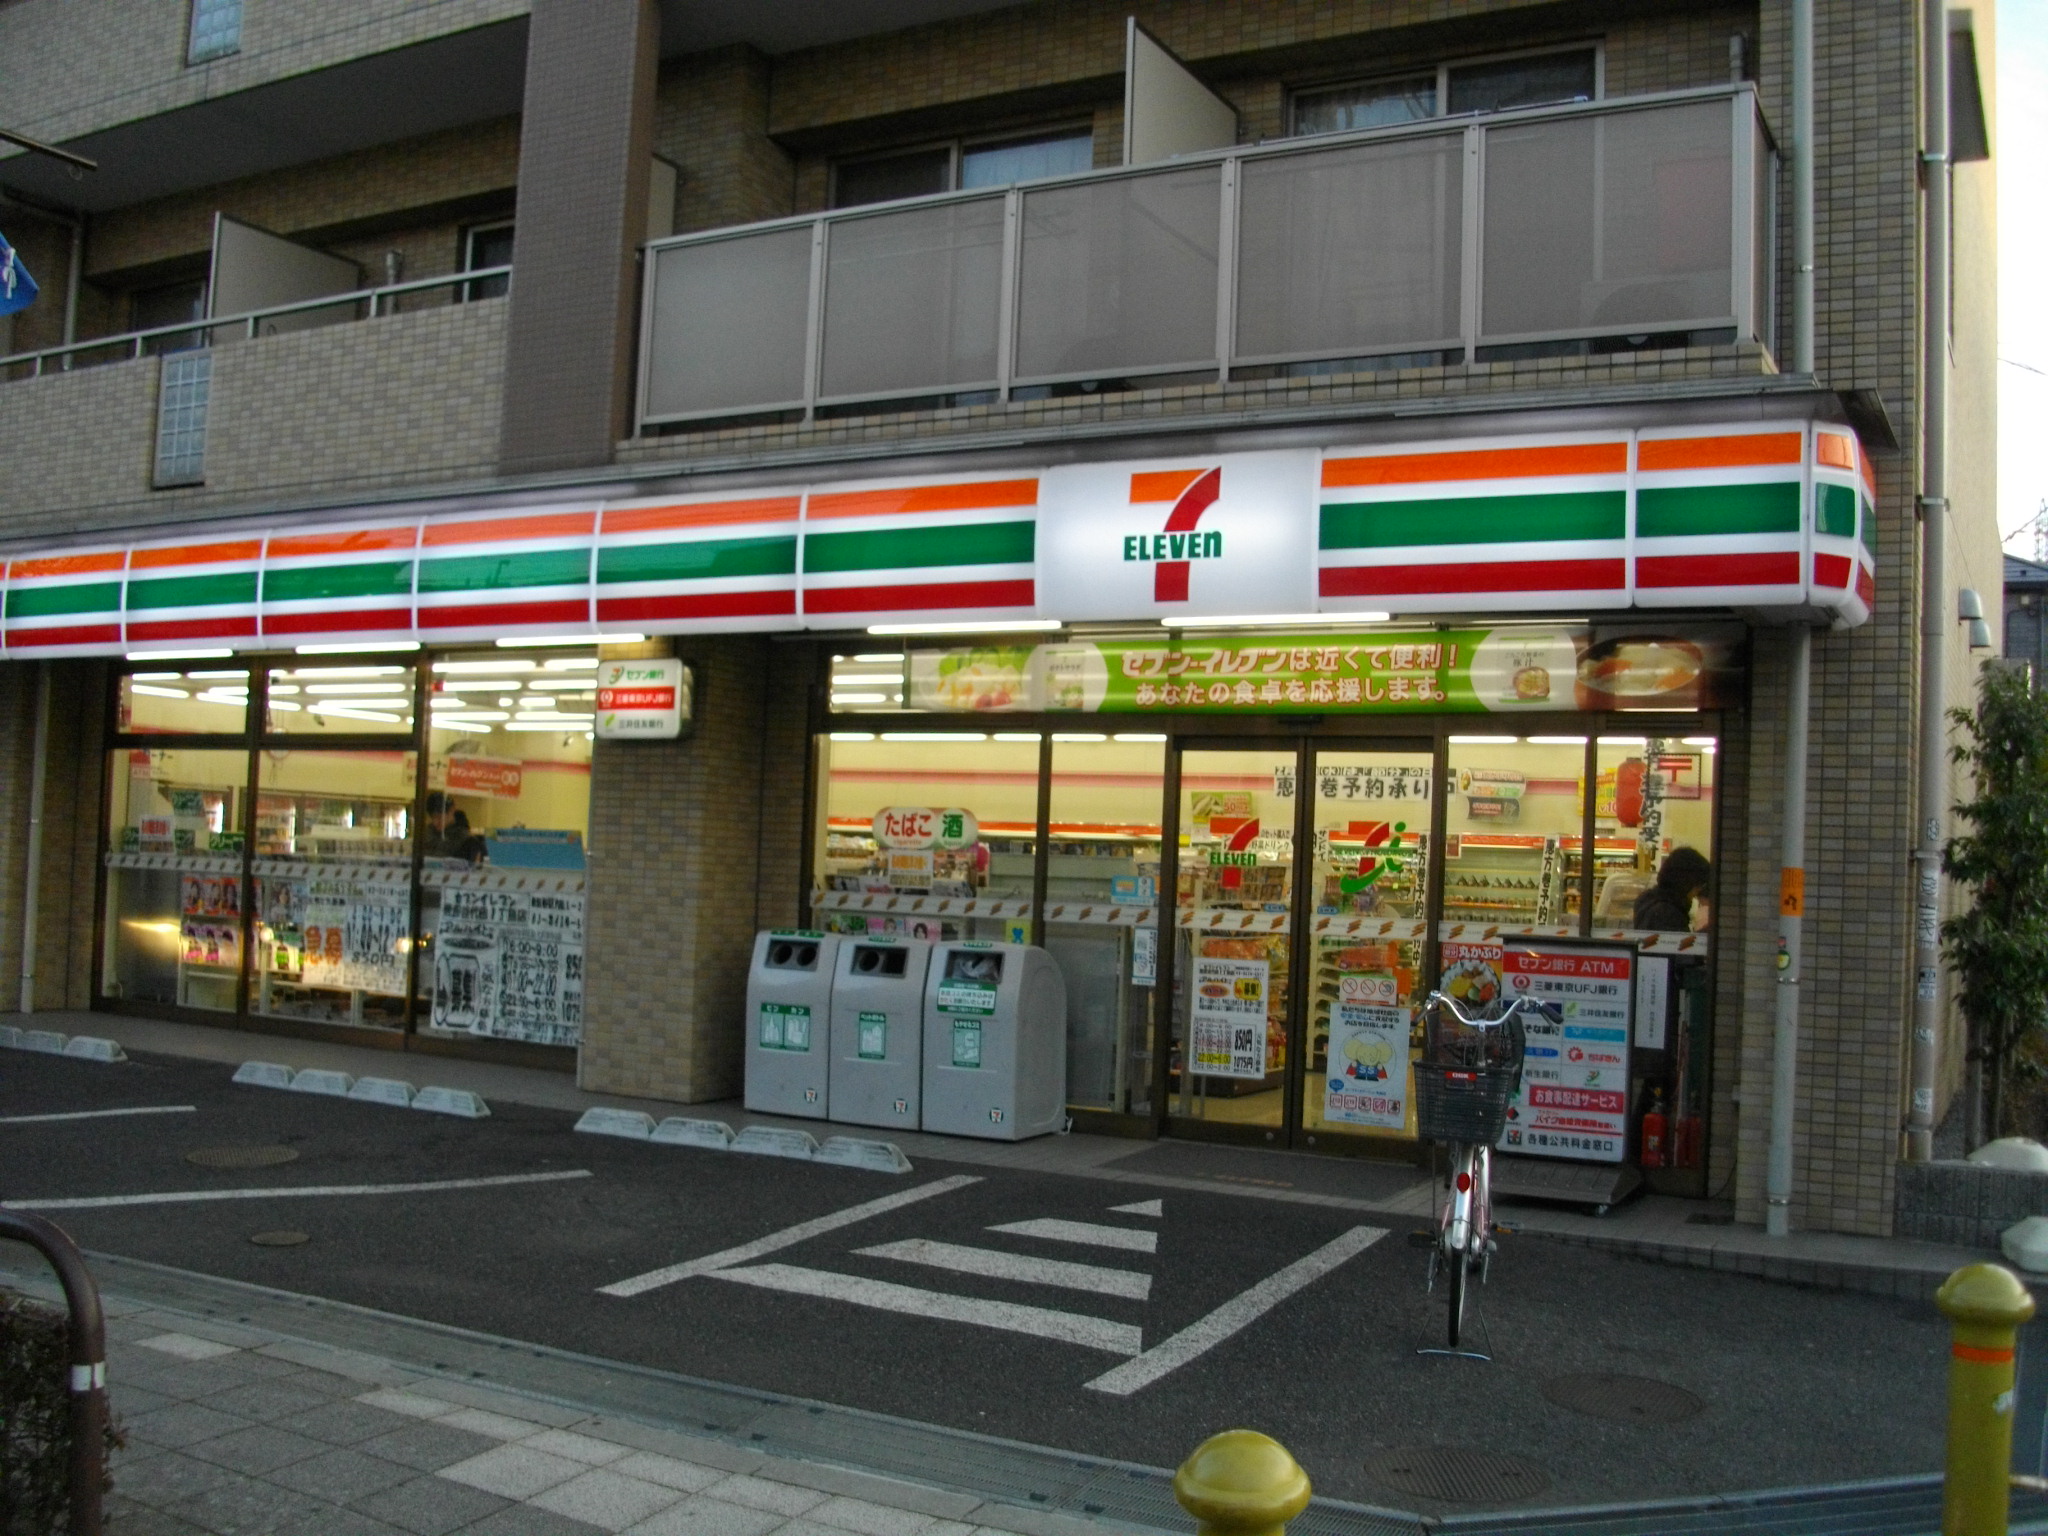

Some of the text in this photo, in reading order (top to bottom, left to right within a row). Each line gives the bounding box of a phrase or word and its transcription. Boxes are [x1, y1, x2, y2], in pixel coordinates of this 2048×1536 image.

[884, 812, 933, 838] たばこ
[941, 813, 964, 839] 酒
[1517, 956, 1615, 974] セブン銀行 ATM
[1534, 980, 1618, 996] 三菱東京UFJ銀行
[1534, 1088, 1618, 1109] お食事配達サービス
[1527, 1133, 1614, 1152] 各種公共料金窓口
